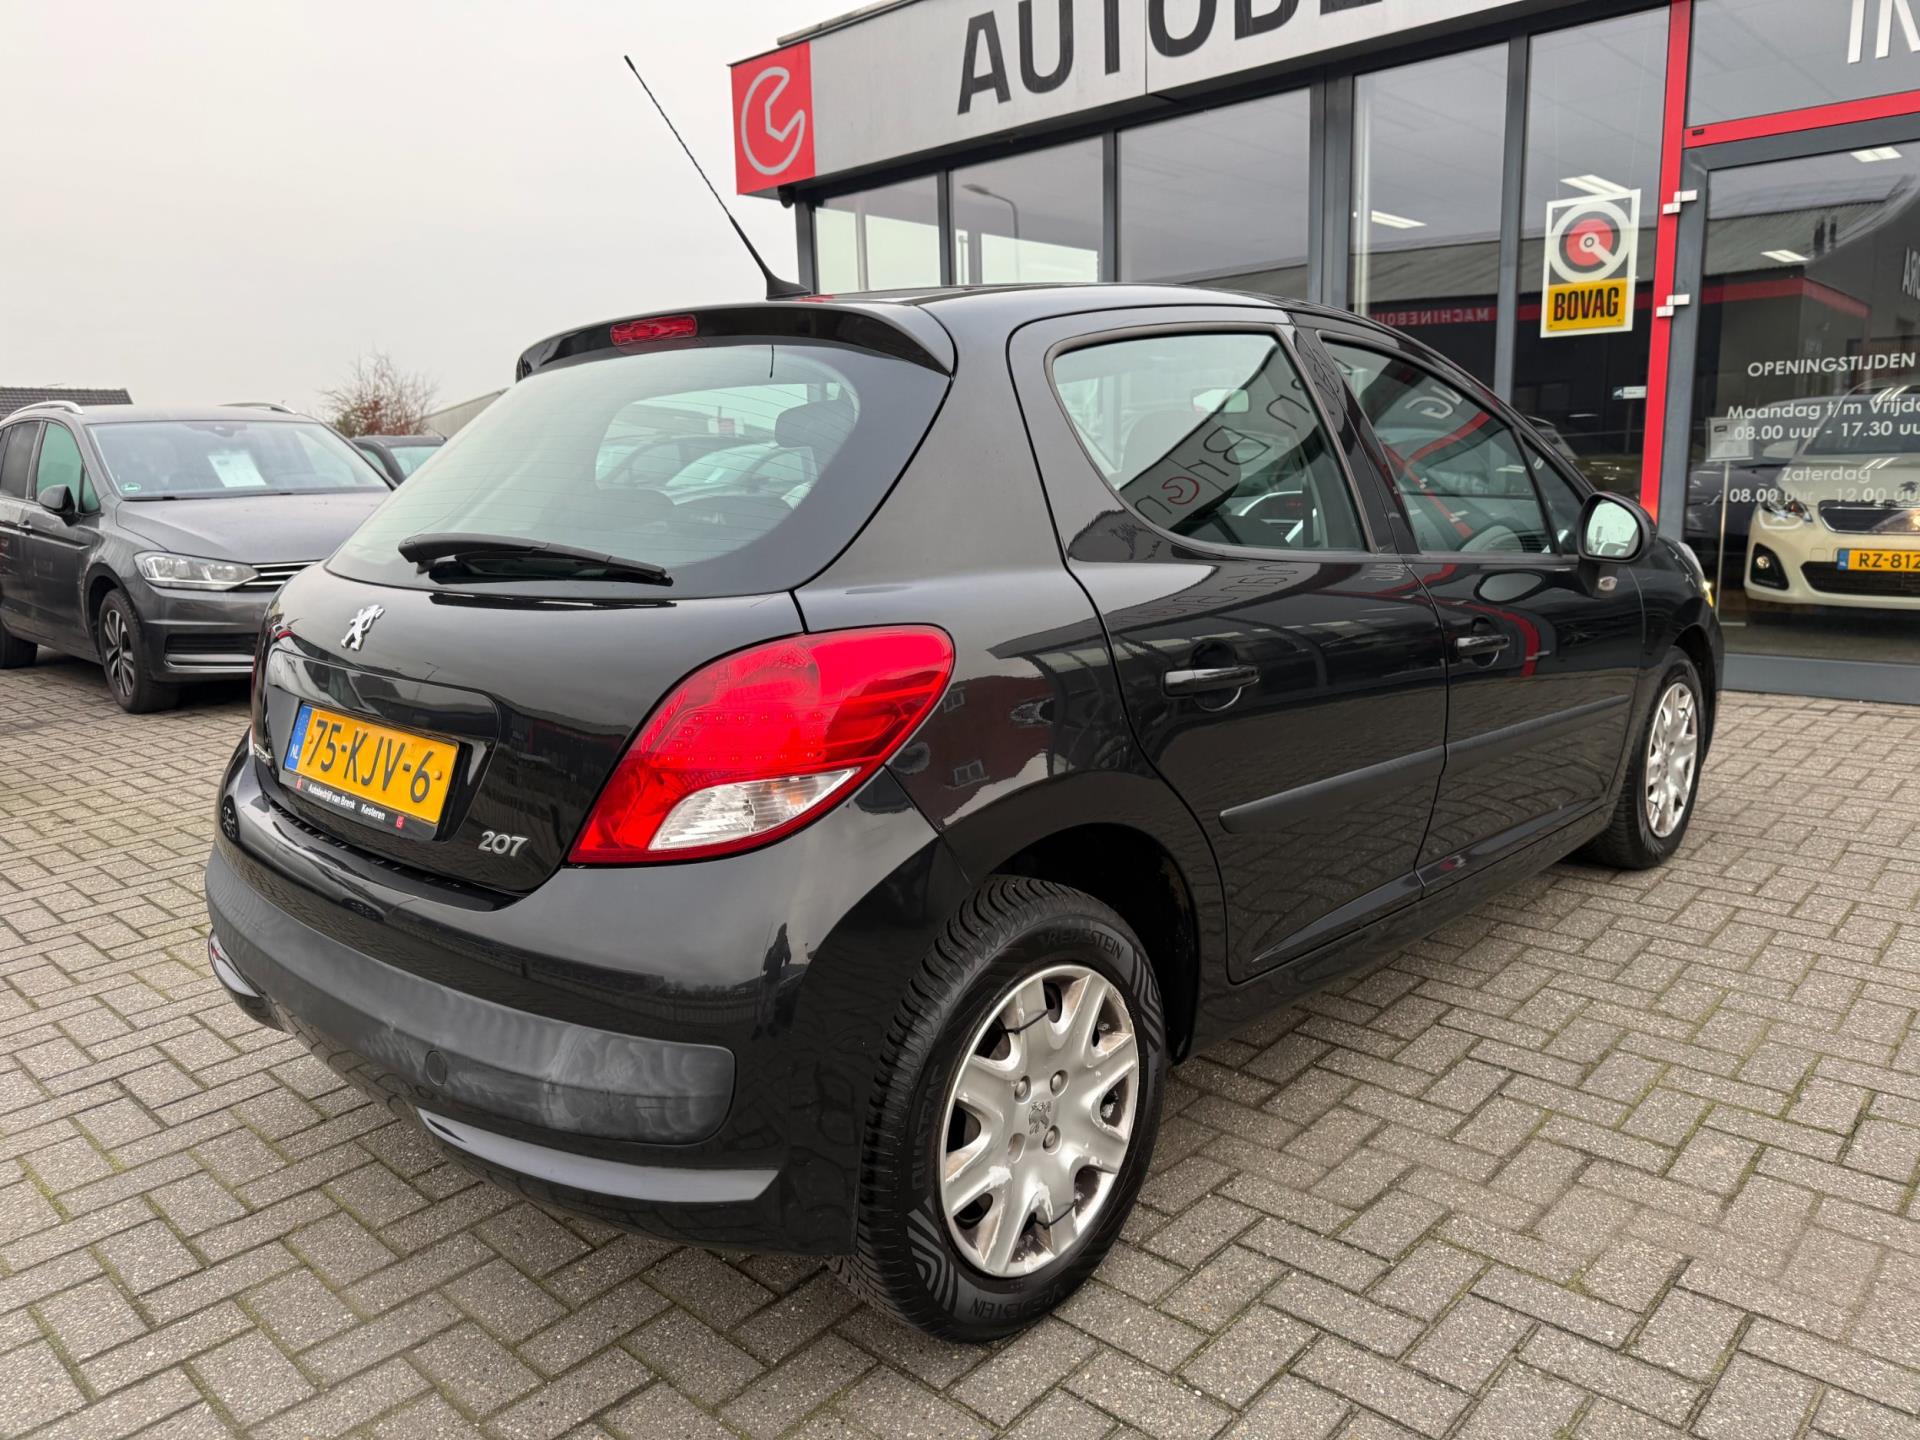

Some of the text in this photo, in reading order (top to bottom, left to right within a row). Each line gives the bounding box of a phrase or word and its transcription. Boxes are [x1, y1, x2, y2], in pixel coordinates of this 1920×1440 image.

[957, 0, 1384, 114] AUTO
[1553, 287, 1619, 322] BOVAG
[1747, 352, 1915, 377] OPENINGSTIJDEN
[1728, 403, 1820, 419] Maandag
[1827, 401, 1861, 418] t/m
[1734, 425, 1783, 441] 08.00
[1789, 427, 1819, 439] uur
[1841, 420, 1893, 437] 17.30
[1782, 466, 1871, 485] Zaterdag
[1729, 488, 1779, 503] 08.00
[1836, 487, 1887, 503] 12.00
[1858, 552, 1920, 569] RZ-812
[307, 719, 434, 803] 75-KJV-6
[360, 803, 386, 821] Kesteren
[478, 830, 530, 857] 207
[1037, 927, 1125, 961] REESTEIN
